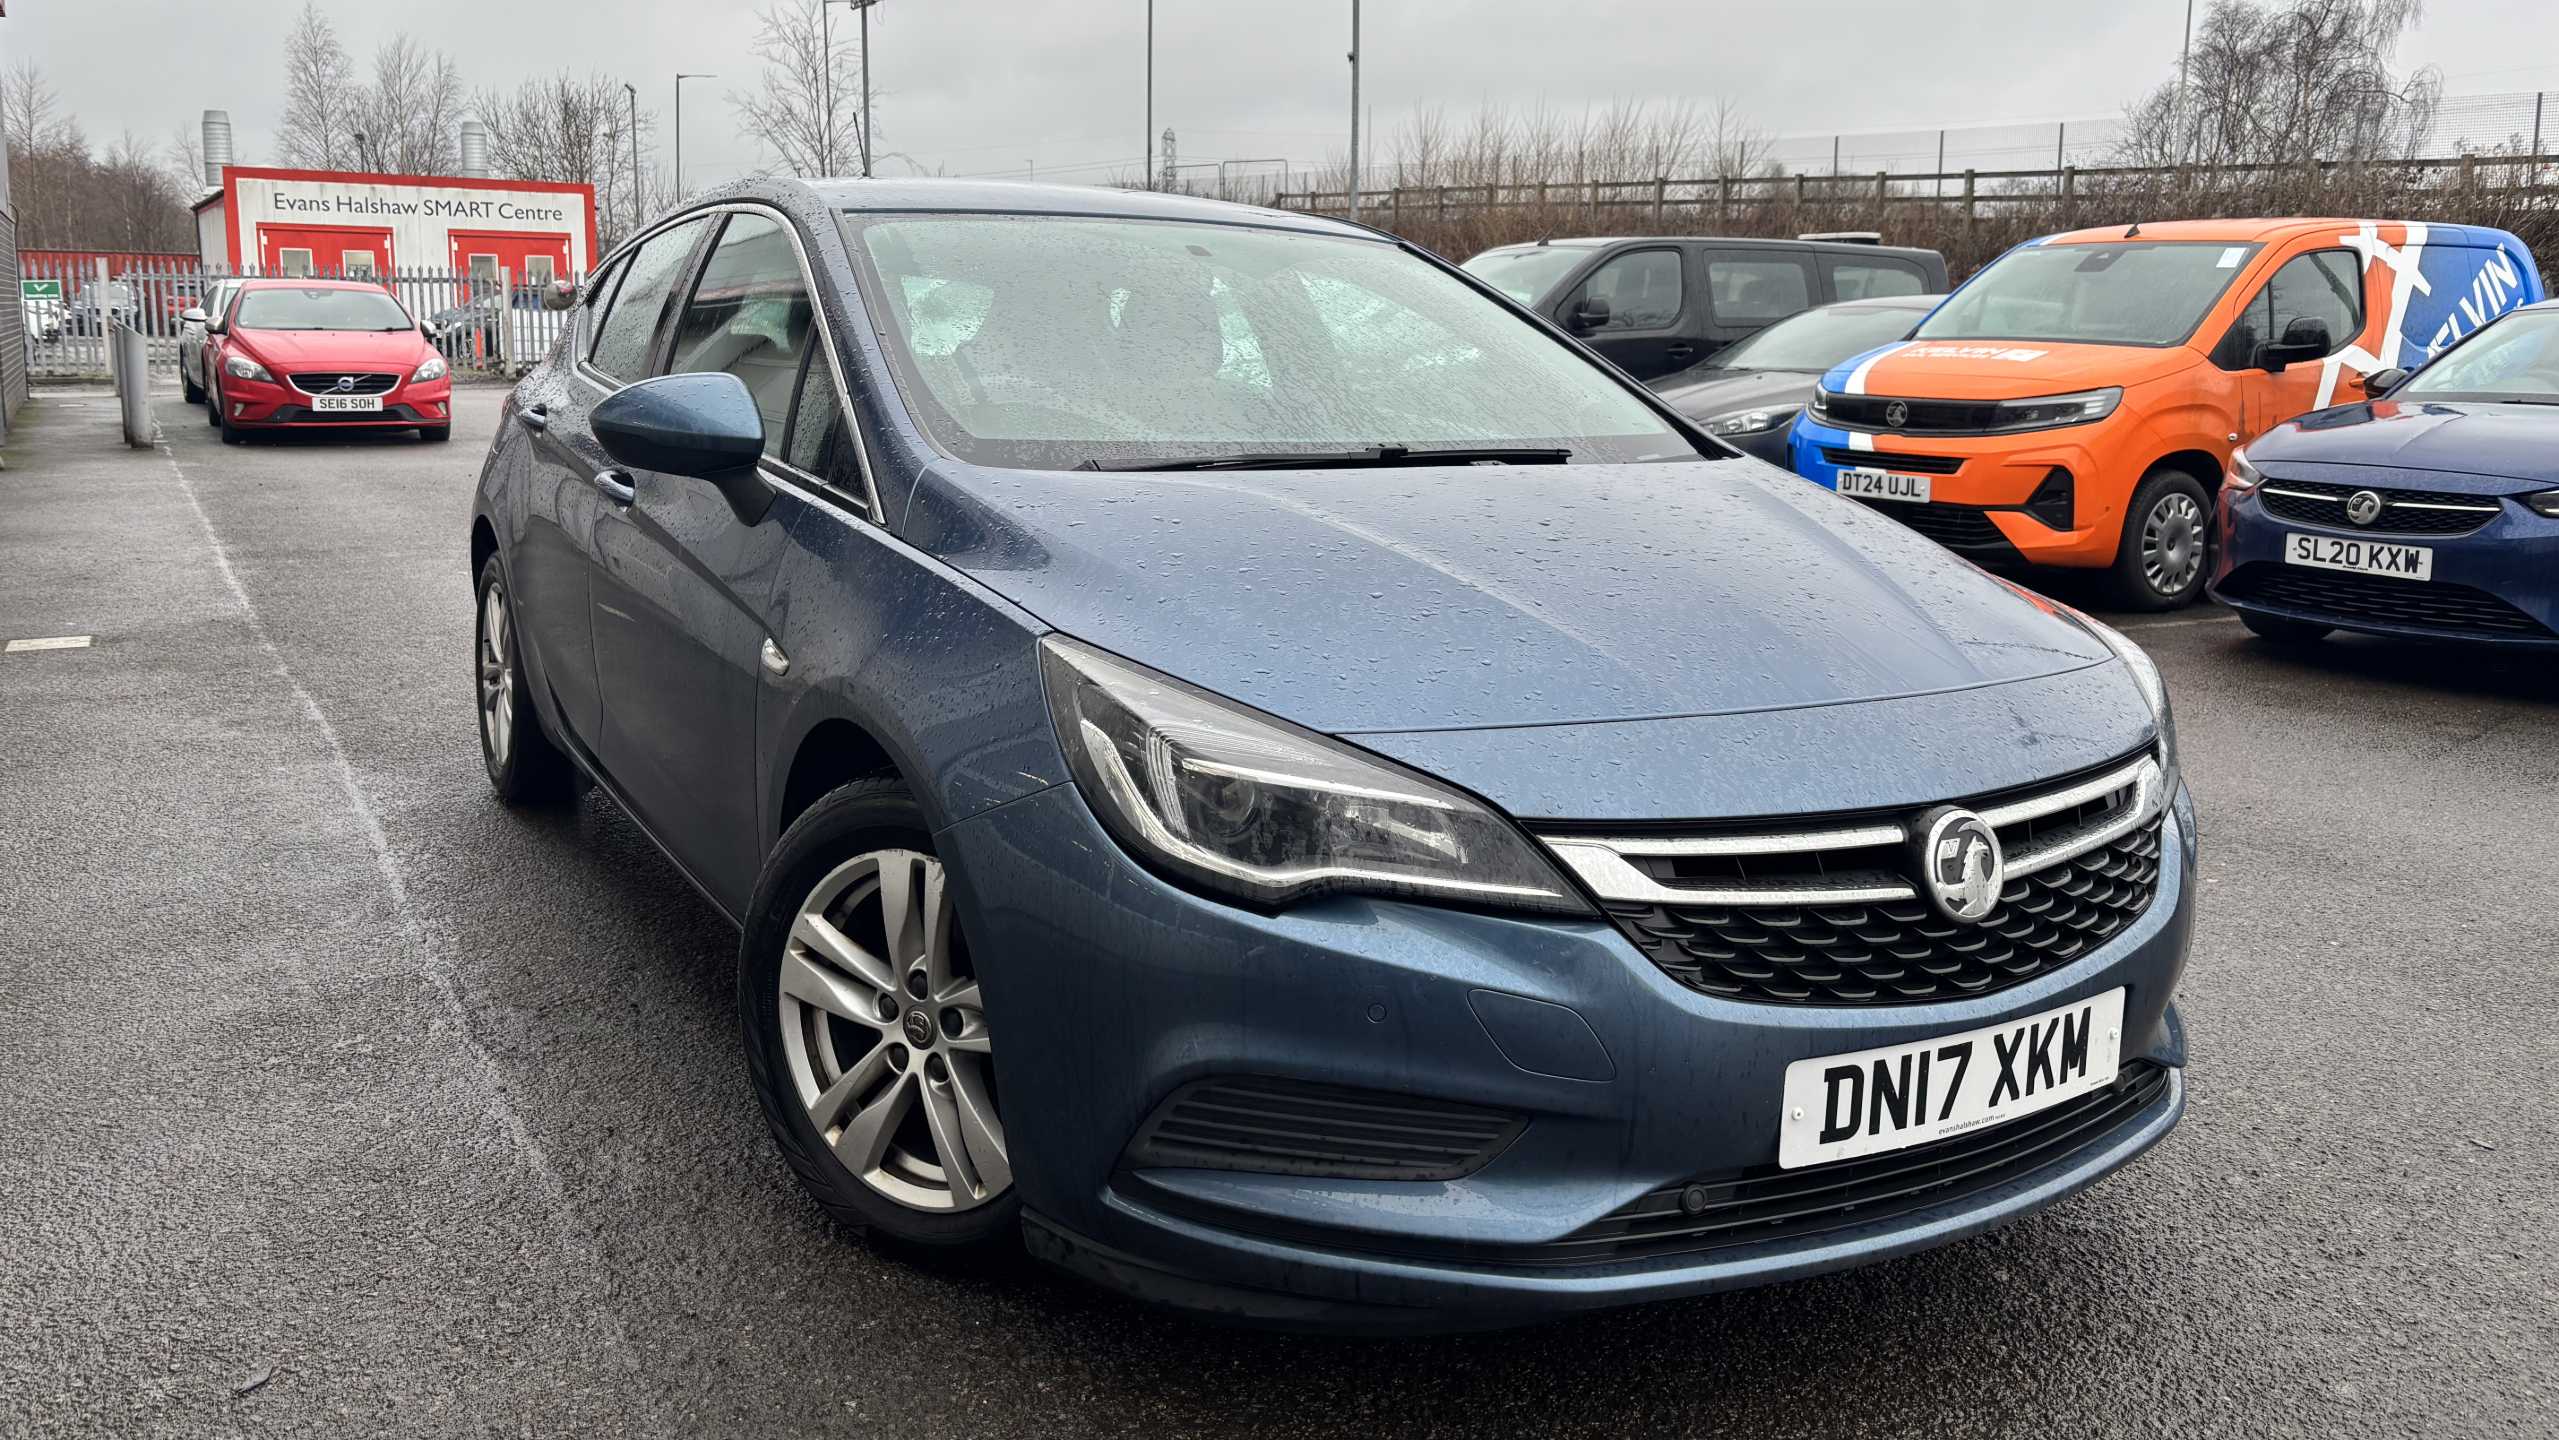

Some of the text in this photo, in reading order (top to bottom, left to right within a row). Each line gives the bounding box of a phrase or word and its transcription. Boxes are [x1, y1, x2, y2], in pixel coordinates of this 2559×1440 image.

[273, 192, 564, 222] Evans Halshaw SMART Centre
[320, 398, 375, 409] SE16 SOH
[1842, 472, 1921, 497] DT24 UJL
[2297, 536, 2420, 574] SL20 KXW
[1819, 1006, 2091, 1145] DN17 XKM
